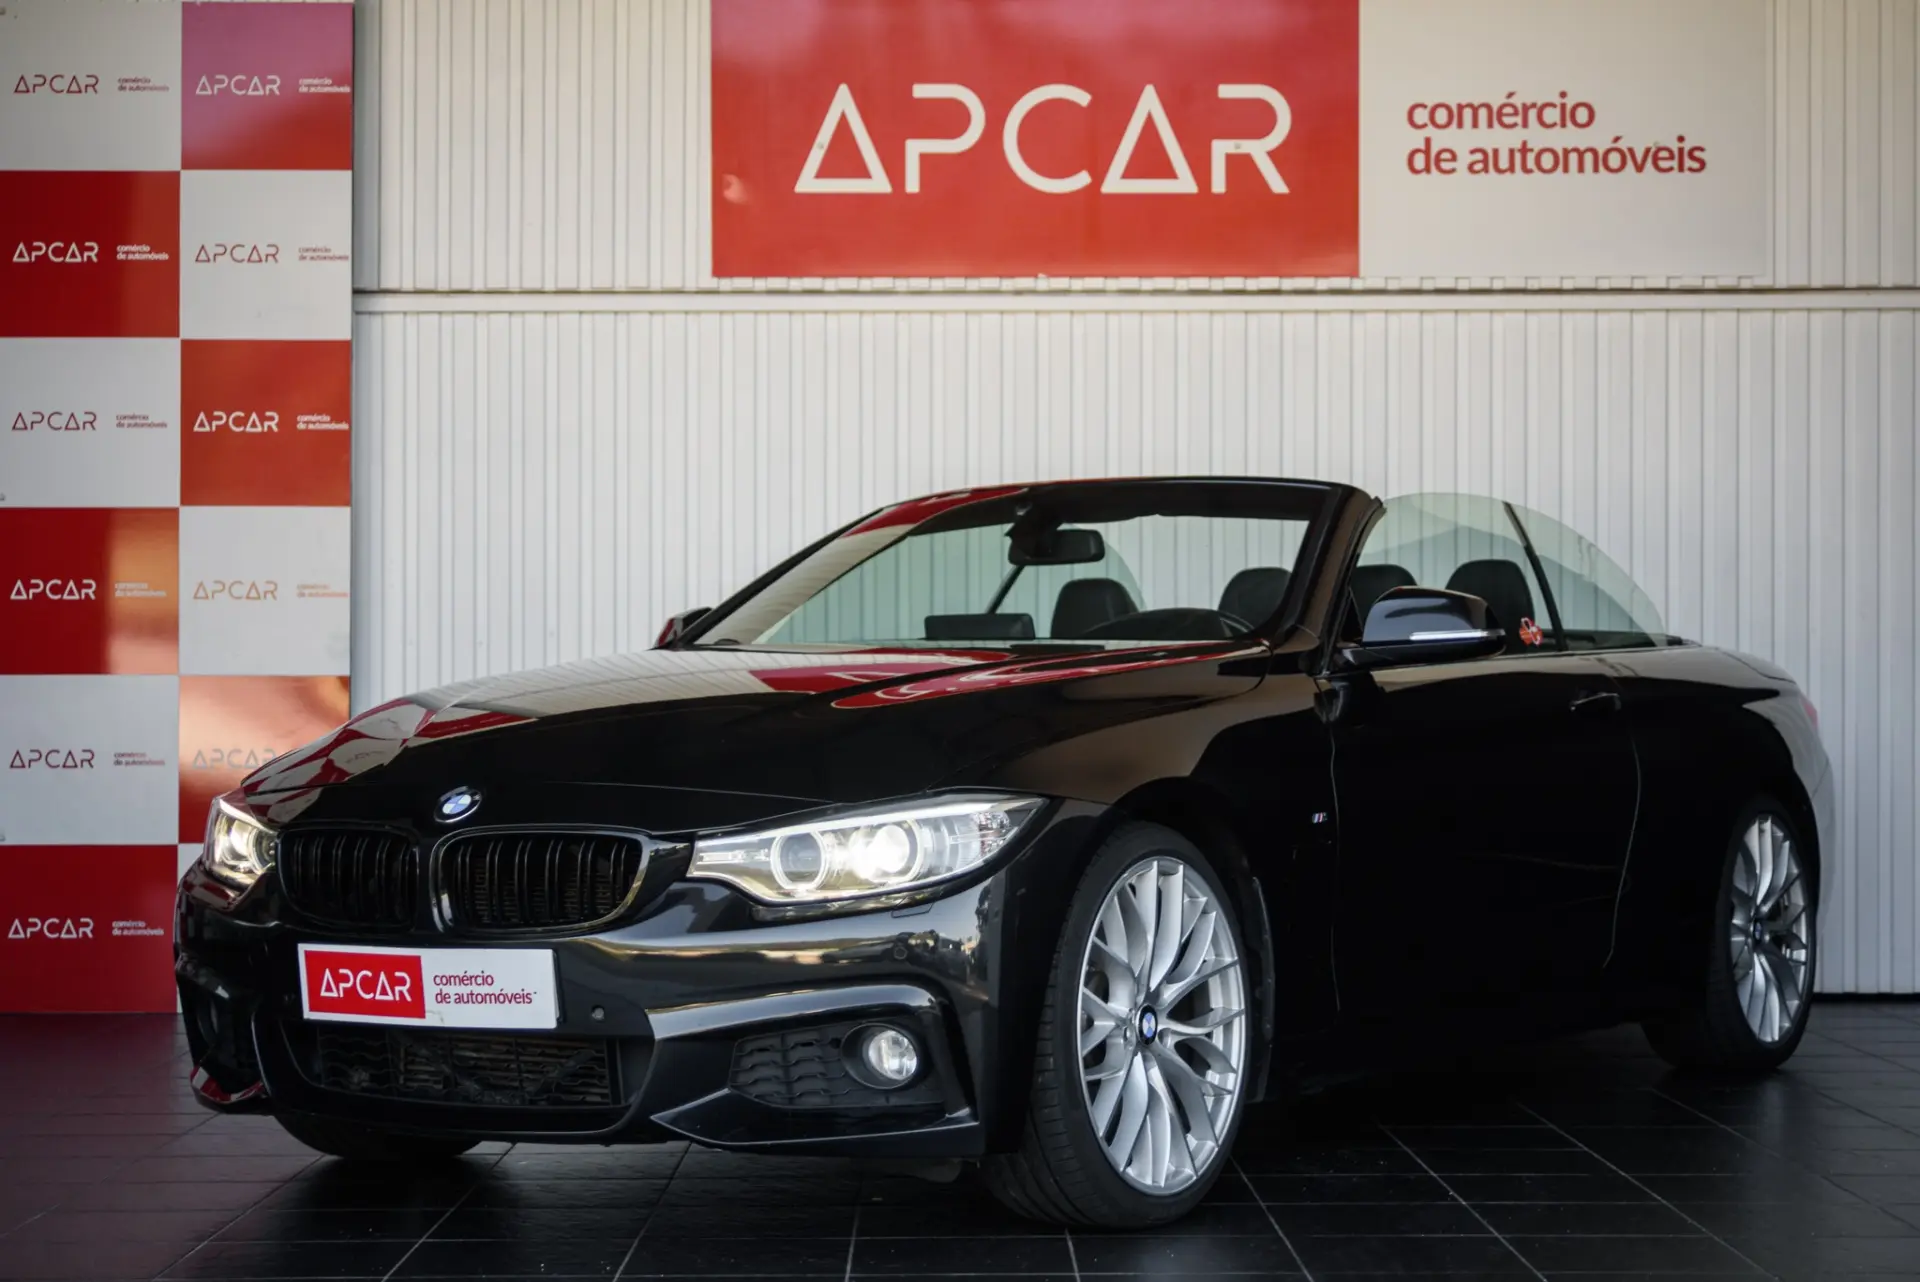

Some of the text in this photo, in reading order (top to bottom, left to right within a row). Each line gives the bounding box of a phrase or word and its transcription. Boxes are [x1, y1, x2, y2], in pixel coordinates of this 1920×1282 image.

[14, 74, 100, 94] APCAR
[117, 84, 127, 92] de
[195, 74, 281, 95] APCAR
[1406, 90, 1596, 129] comércio
[795, 83, 1291, 194] APCAR
[1407, 136, 1706, 174] de automóveis
[12, 241, 100, 263] APCAR
[116, 252, 126, 260] de
[194, 243, 280, 263] APCAR
[11, 411, 97, 431] APCAR
[116, 420, 125, 428] de
[193, 411, 280, 432] APCAR
[10, 578, 97, 600] APCAR
[192, 580, 279, 600] APCAR
[9, 749, 95, 769] APCAR
[7, 918, 94, 939] APCAR
[320, 967, 412, 1002] APCAR
[433, 970, 494, 987] comércio
[435, 988, 533, 1005] de automóveis
